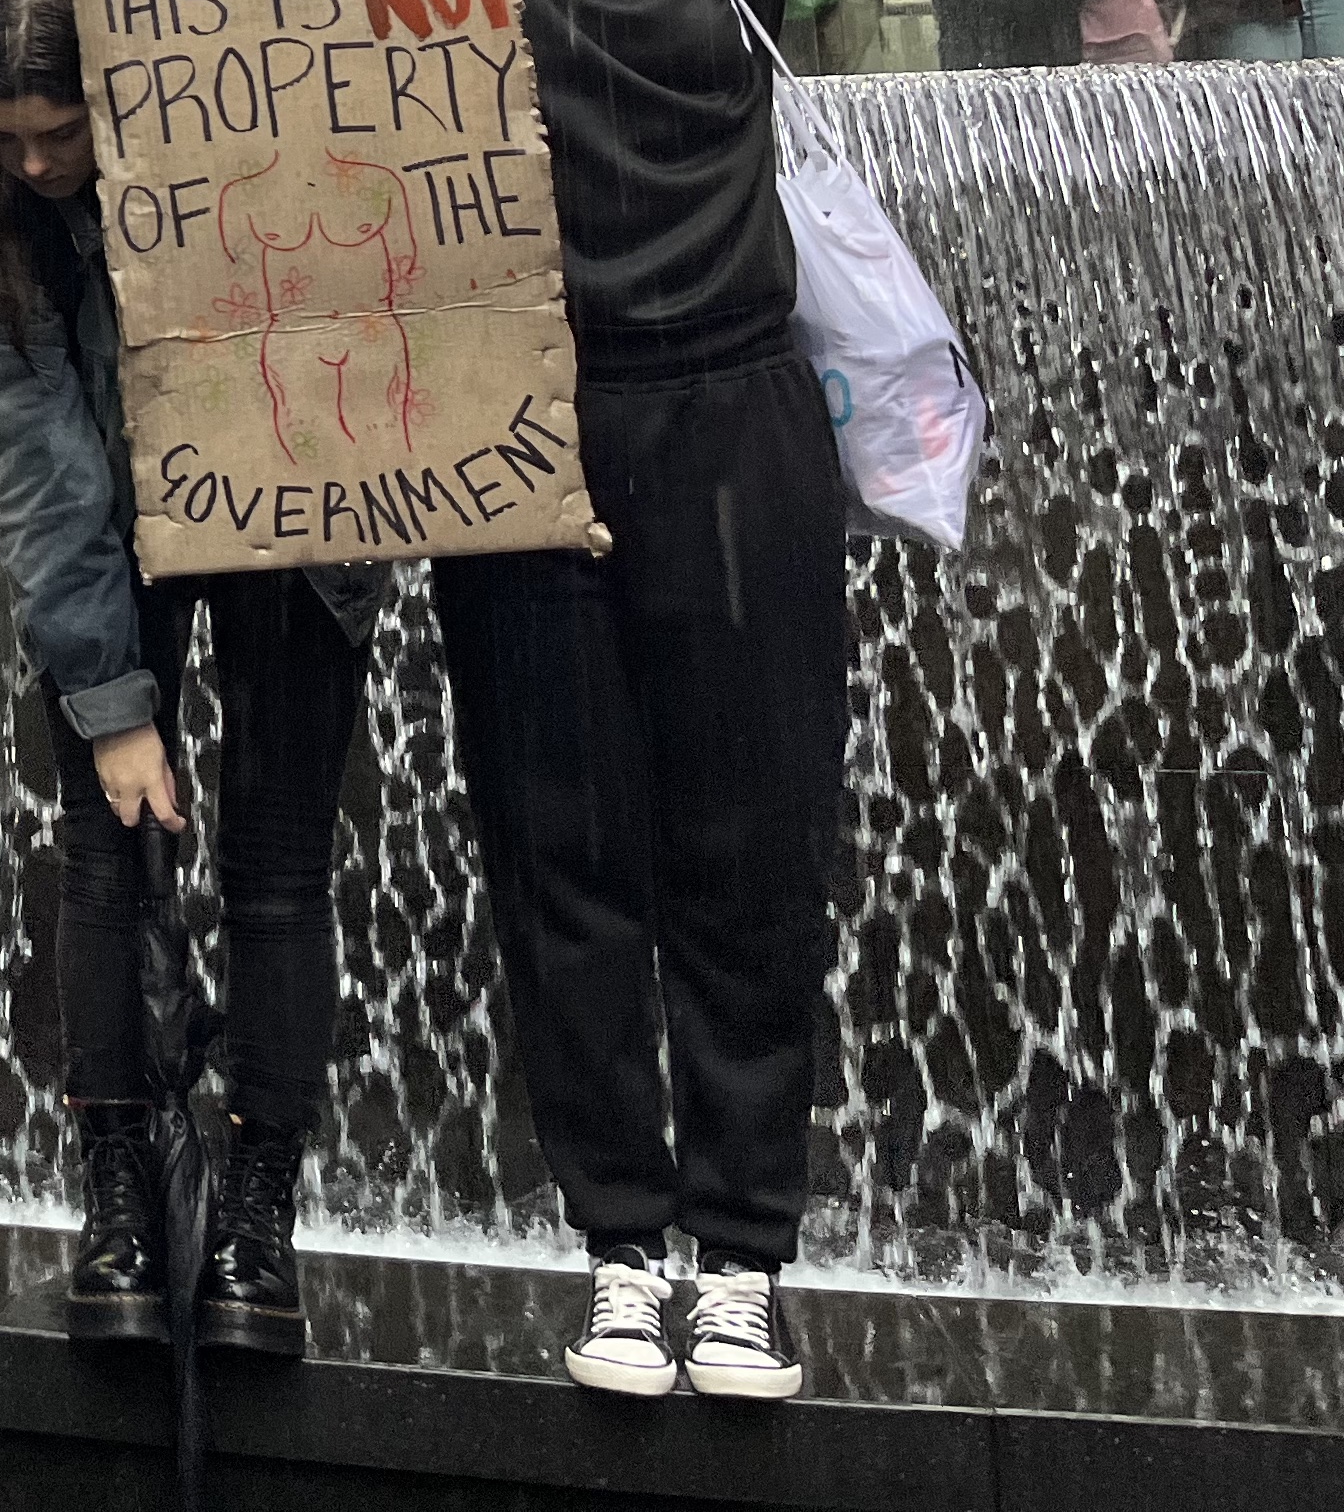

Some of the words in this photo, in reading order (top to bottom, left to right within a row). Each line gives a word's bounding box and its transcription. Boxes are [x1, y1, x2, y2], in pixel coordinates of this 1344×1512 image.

[103, 35, 518, 160] PROPERTY
[116, 175, 211, 254] OF
[401, 148, 542, 247] THE
[160, 393, 568, 546] GOVERNMENT
